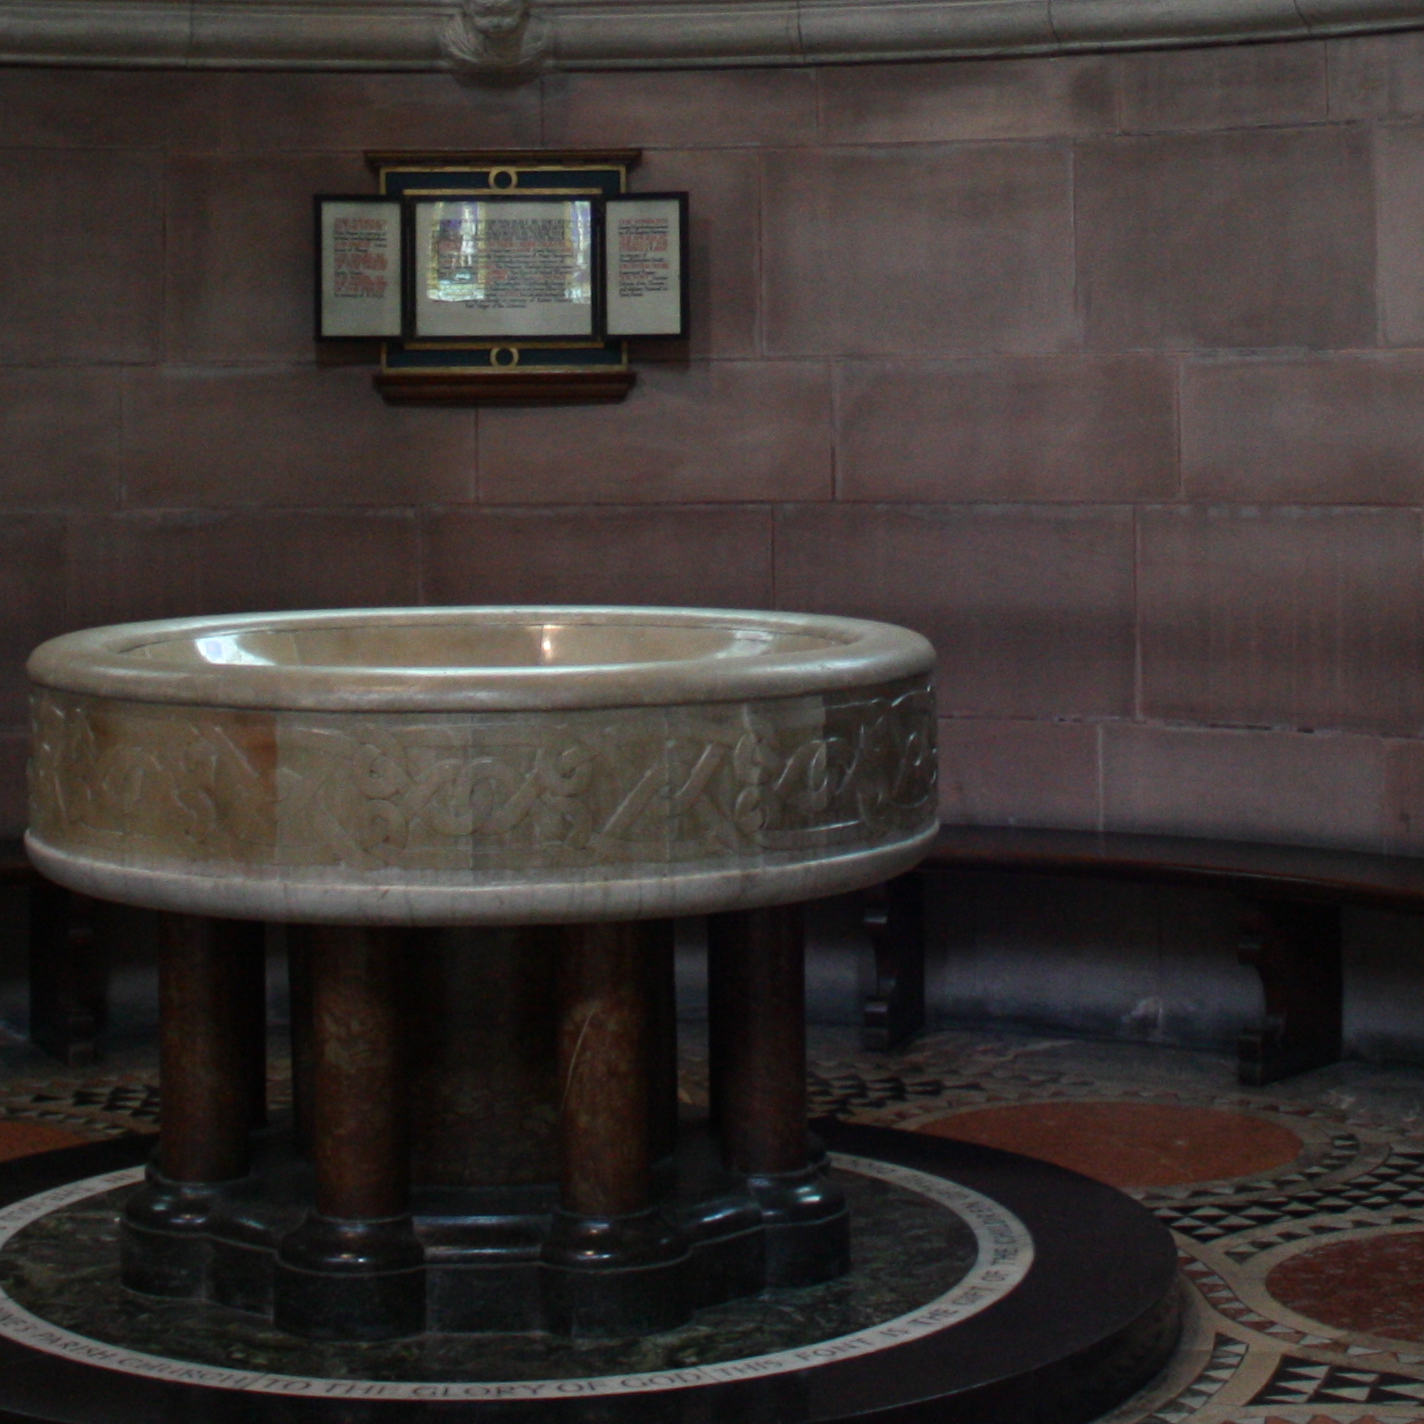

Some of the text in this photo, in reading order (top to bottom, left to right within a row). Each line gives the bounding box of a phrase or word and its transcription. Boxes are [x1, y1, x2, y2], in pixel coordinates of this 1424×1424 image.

[265, 1378, 311, 1391] TO
[412, 1384, 544, 1397] GLORY
[556, 1380, 610, 1394] OF
[621, 1371, 701, 1389] GOD
[717, 1358, 784, 1377] THIS
[795, 1337, 874, 1361] FONT
